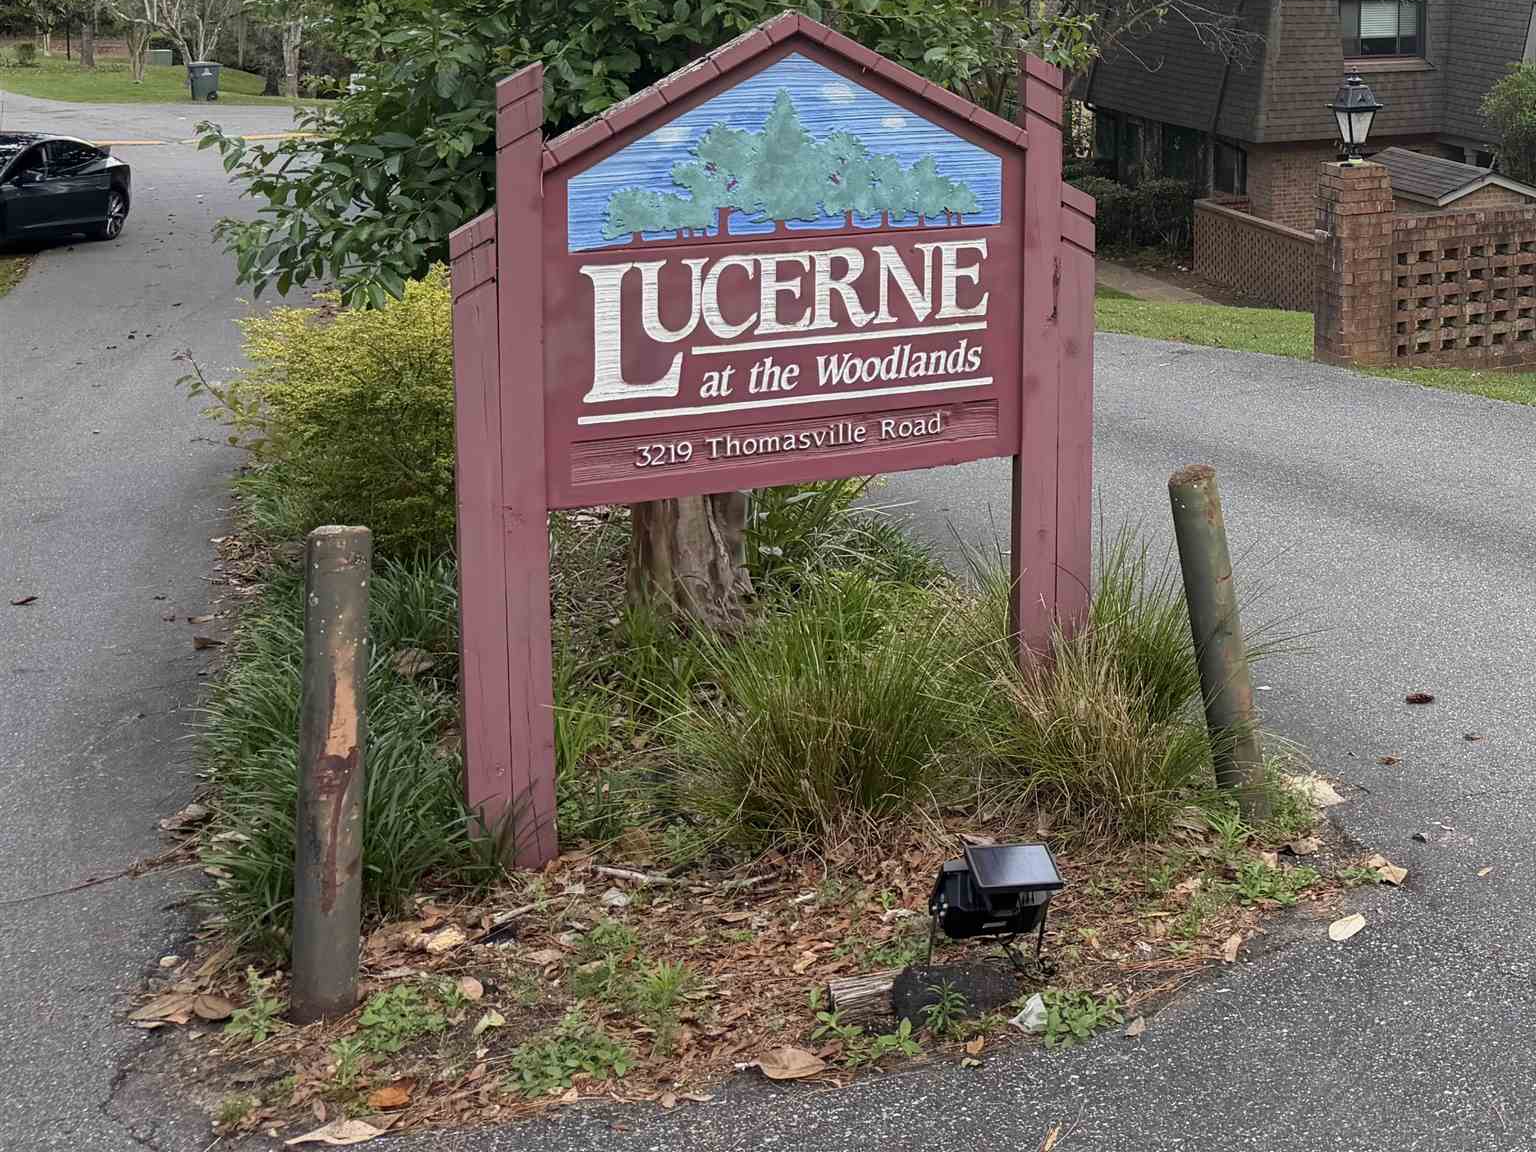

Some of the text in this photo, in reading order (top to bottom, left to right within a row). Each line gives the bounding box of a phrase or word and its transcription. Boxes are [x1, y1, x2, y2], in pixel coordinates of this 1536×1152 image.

[579, 238, 989, 404] LUCERNE
[700, 339, 983, 399] at the Woodlands
[635, 413, 942, 468] 3219 Thomasville Road
